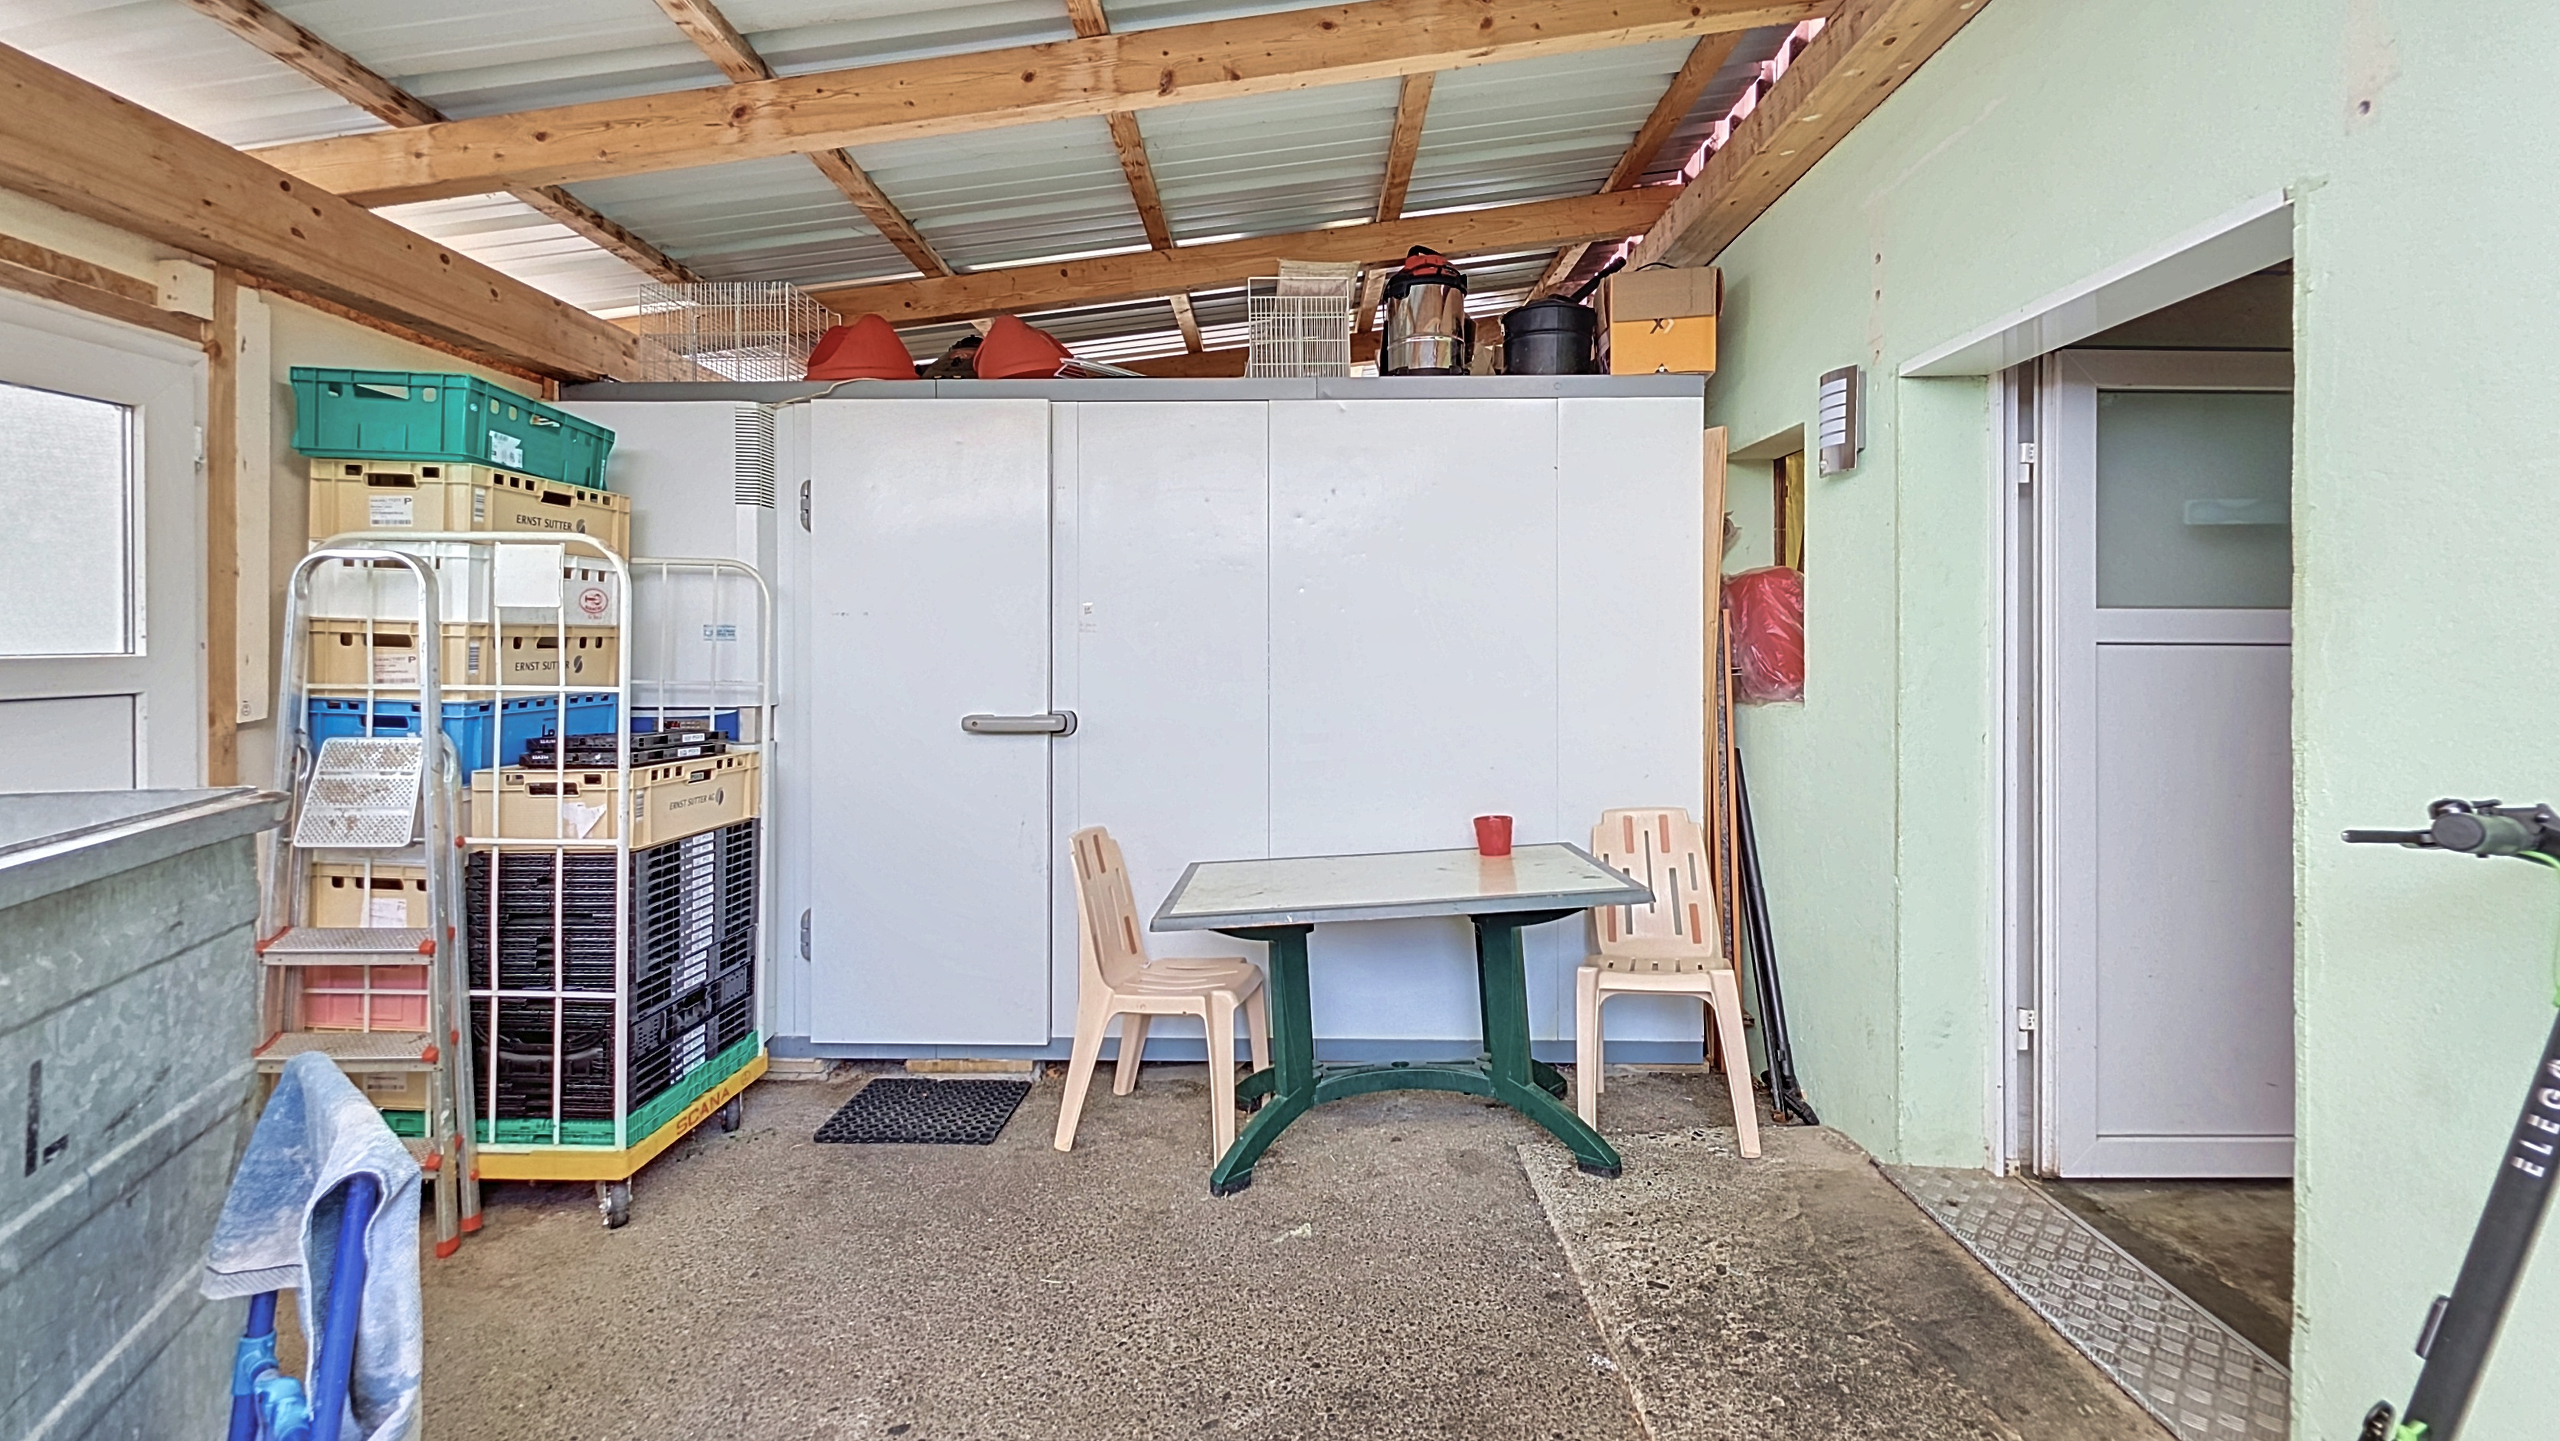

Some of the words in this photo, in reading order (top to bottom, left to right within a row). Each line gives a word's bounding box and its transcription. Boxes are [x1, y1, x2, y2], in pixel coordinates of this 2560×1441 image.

[516, 514, 542, 527] ERNST
[544, 518, 572, 531] SUTTER
[515, 661, 540, 671] ERNST
[542, 660, 570, 671] SUTR
[669, 799, 687, 811] ERNST
[687, 794, 707, 807] SUTTER
[676, 1087, 730, 1136] SCANA
